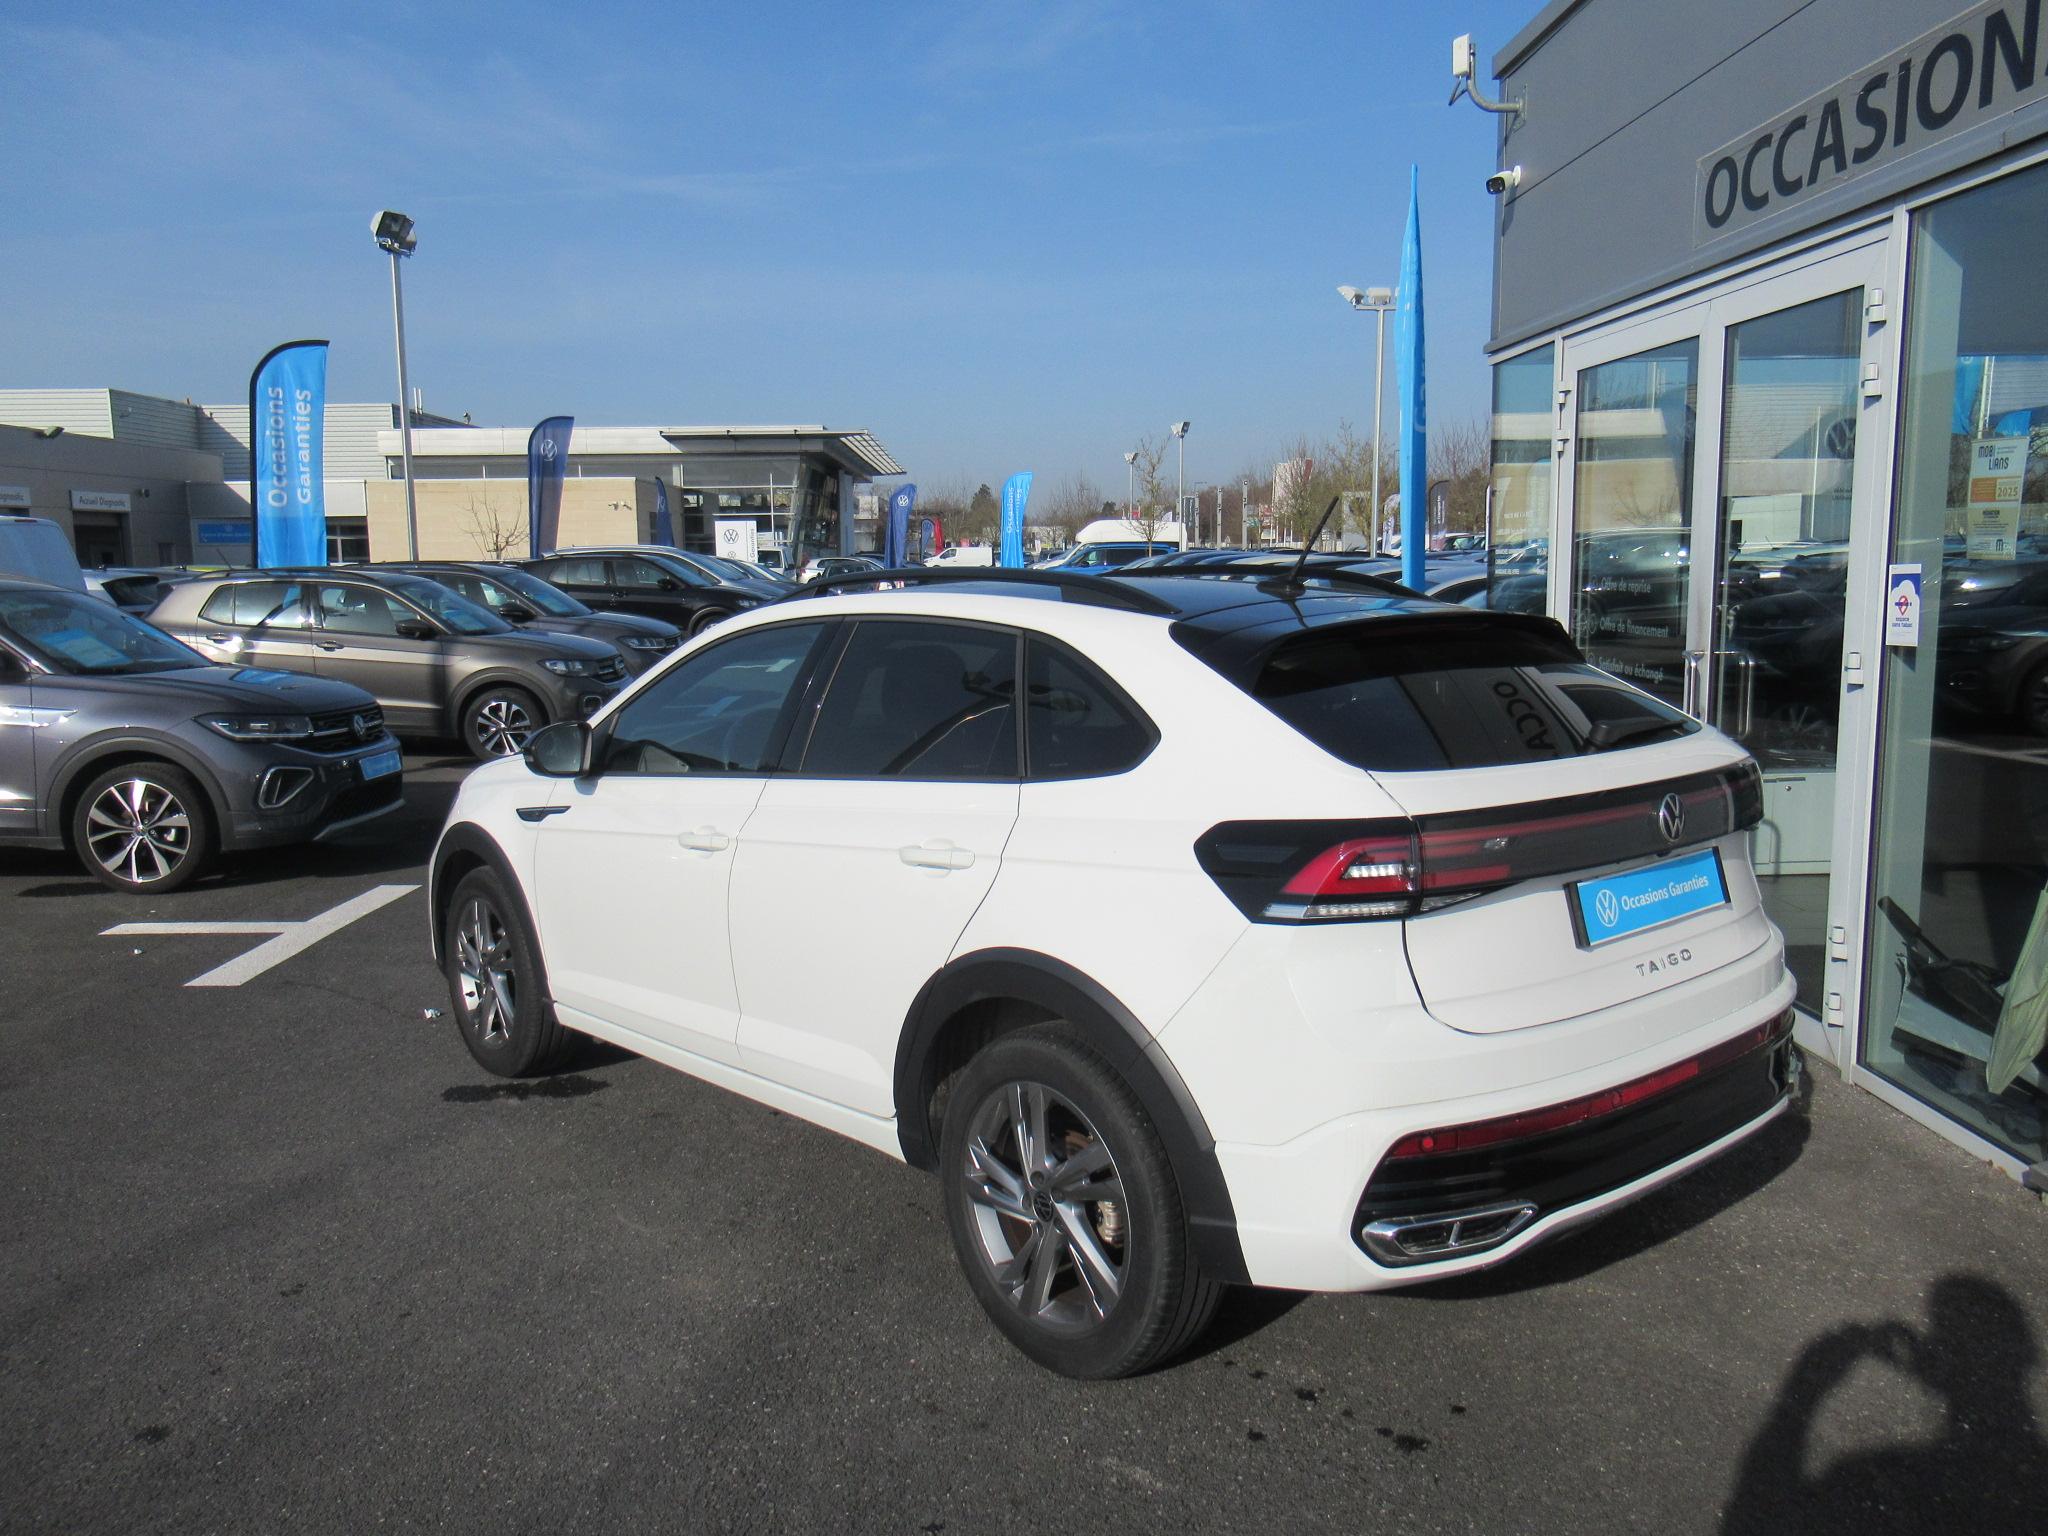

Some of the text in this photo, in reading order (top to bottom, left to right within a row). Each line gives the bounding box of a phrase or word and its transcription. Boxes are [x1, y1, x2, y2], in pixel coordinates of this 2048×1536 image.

[1704, 0, 2048, 229] OCCASION
[265, 387, 287, 508] Occasions
[292, 389, 312, 504] Garanties
[1998, 487, 2018, 498] 2025
[1601, 577, 1651, 595] Offre de reprise
[1600, 617, 1669, 638] Offre de financement
[1624, 665, 1633, 675] ou
[1634, 664, 1664, 684] échangé
[1621, 887, 1669, 911] Occasions
[1669, 874, 1709, 896] Garanties
[1636, 949, 1692, 976] TAIGO
